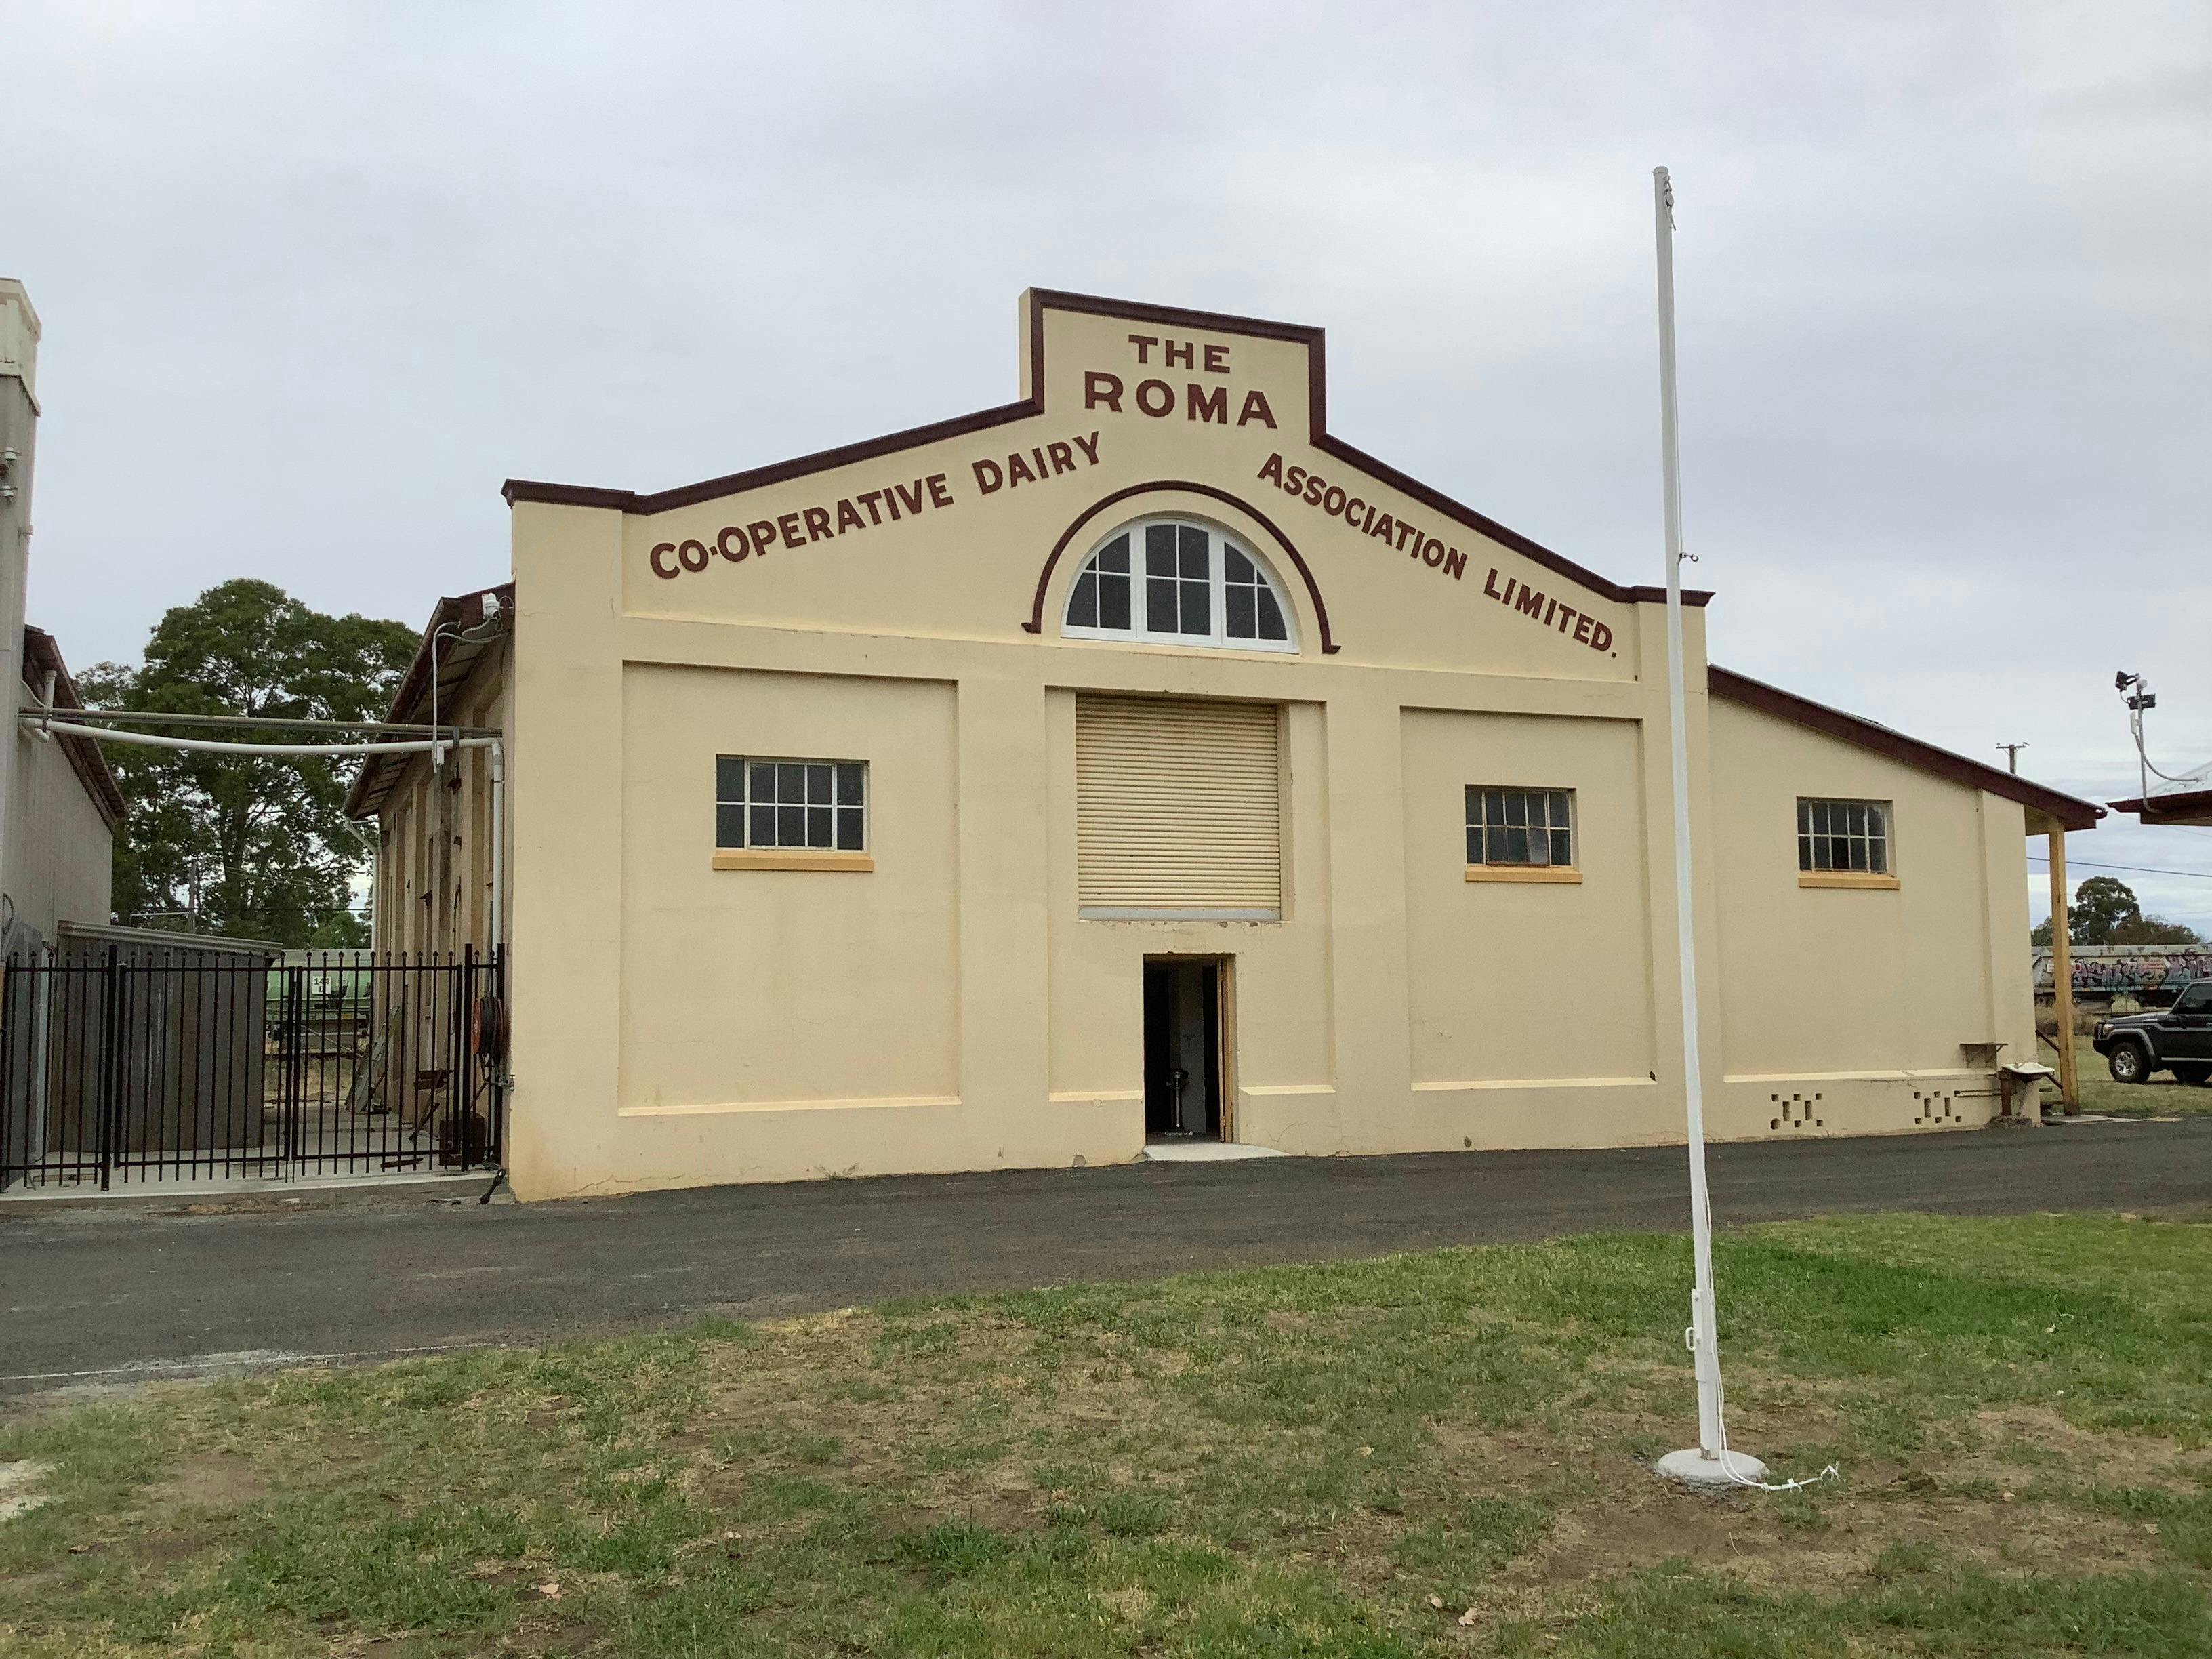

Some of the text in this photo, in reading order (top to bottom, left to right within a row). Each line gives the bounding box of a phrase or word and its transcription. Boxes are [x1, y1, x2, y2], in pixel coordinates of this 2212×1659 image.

[1084, 370, 1278, 430] ROMA
[1128, 333, 1231, 374] THE
[649, 430, 1100, 581] CO-OPERATIVE DAIRY
[1256, 452, 1618, 659] ASSOCIATION LIMITED.
